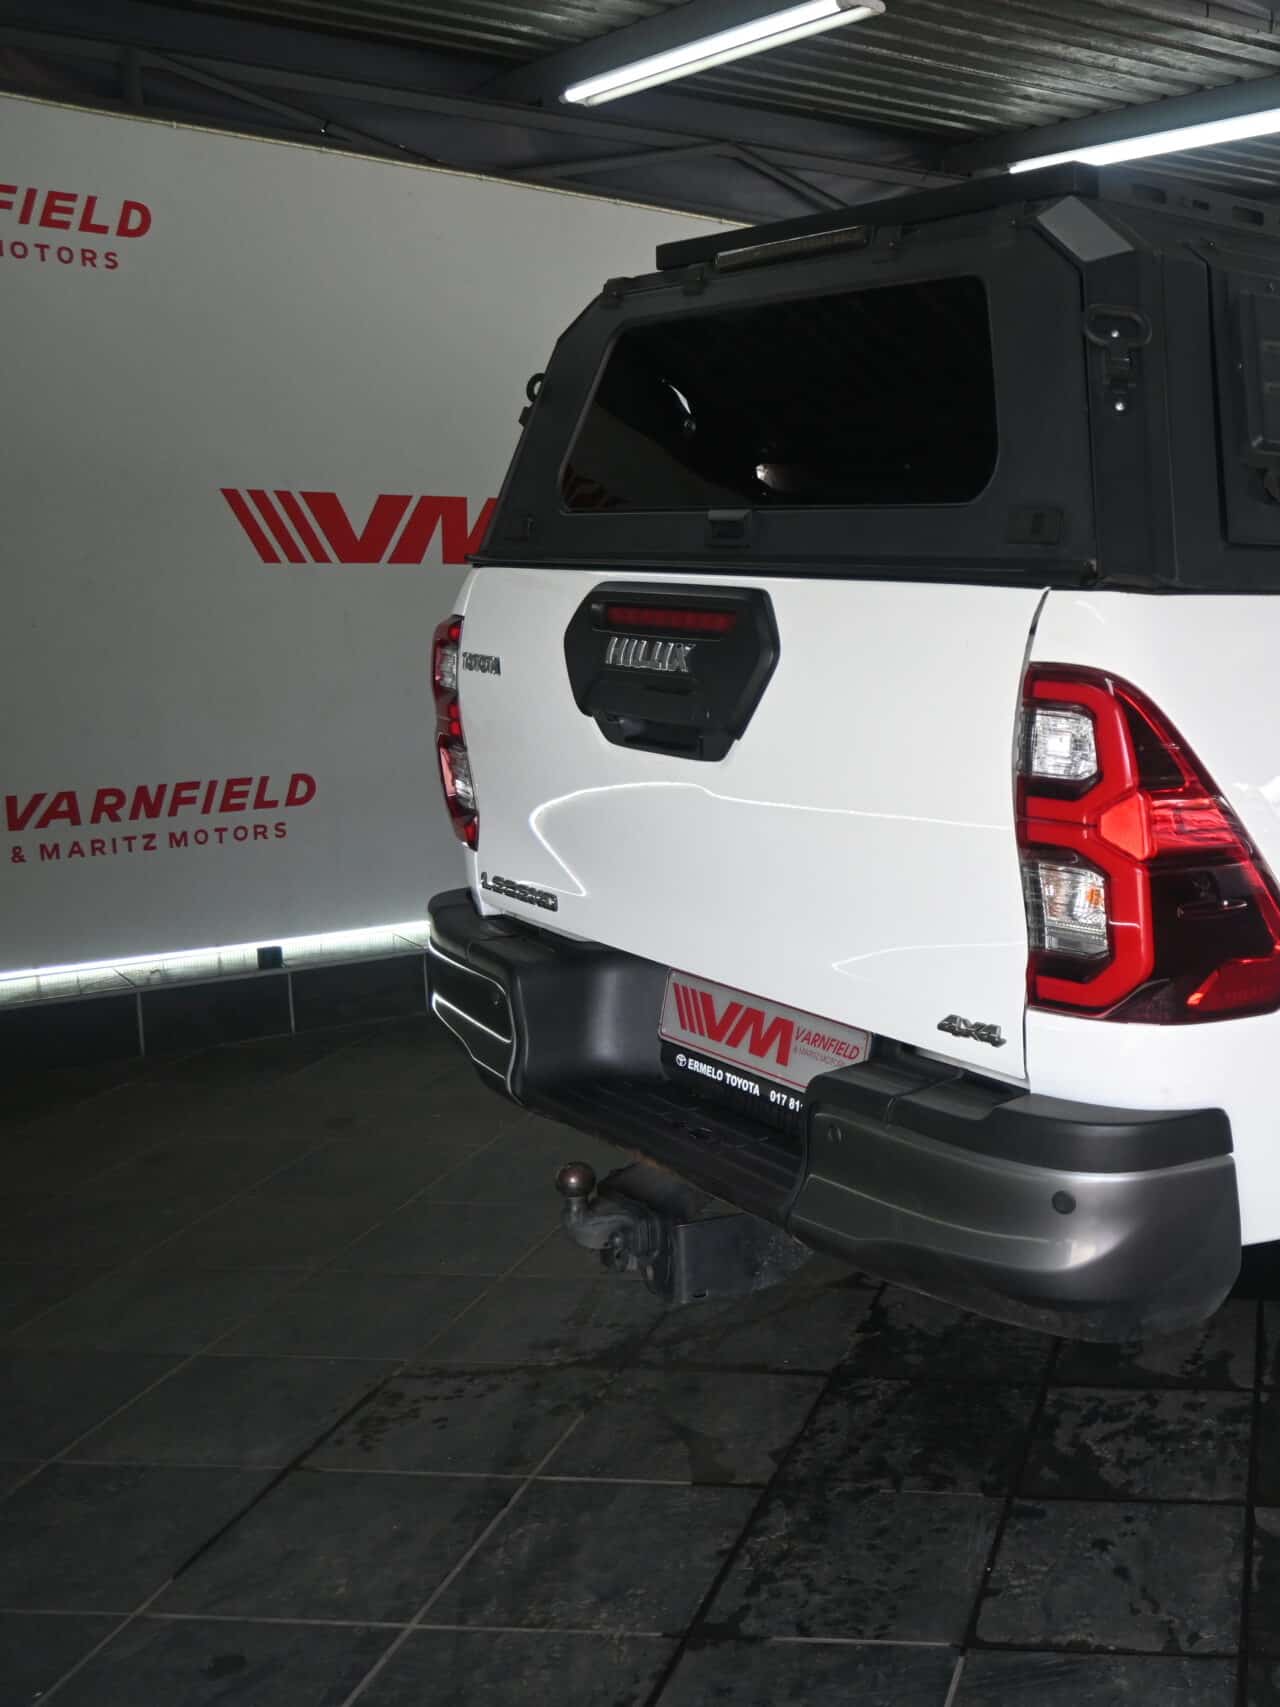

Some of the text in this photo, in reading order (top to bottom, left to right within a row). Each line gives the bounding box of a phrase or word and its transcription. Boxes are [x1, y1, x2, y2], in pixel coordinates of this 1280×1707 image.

[0, 239, 119, 270] OTORS
[605, 636, 696, 673] HILUX
[4, 773, 318, 832] VARNFIELD
[11, 822, 288, 863] & MARITZ MOTORS
[698, 990, 796, 1067] VM
[794, 1025, 861, 1061] VARNFIELD
[687, 1057, 803, 1113] ERMELO TOYOTA 017 81
